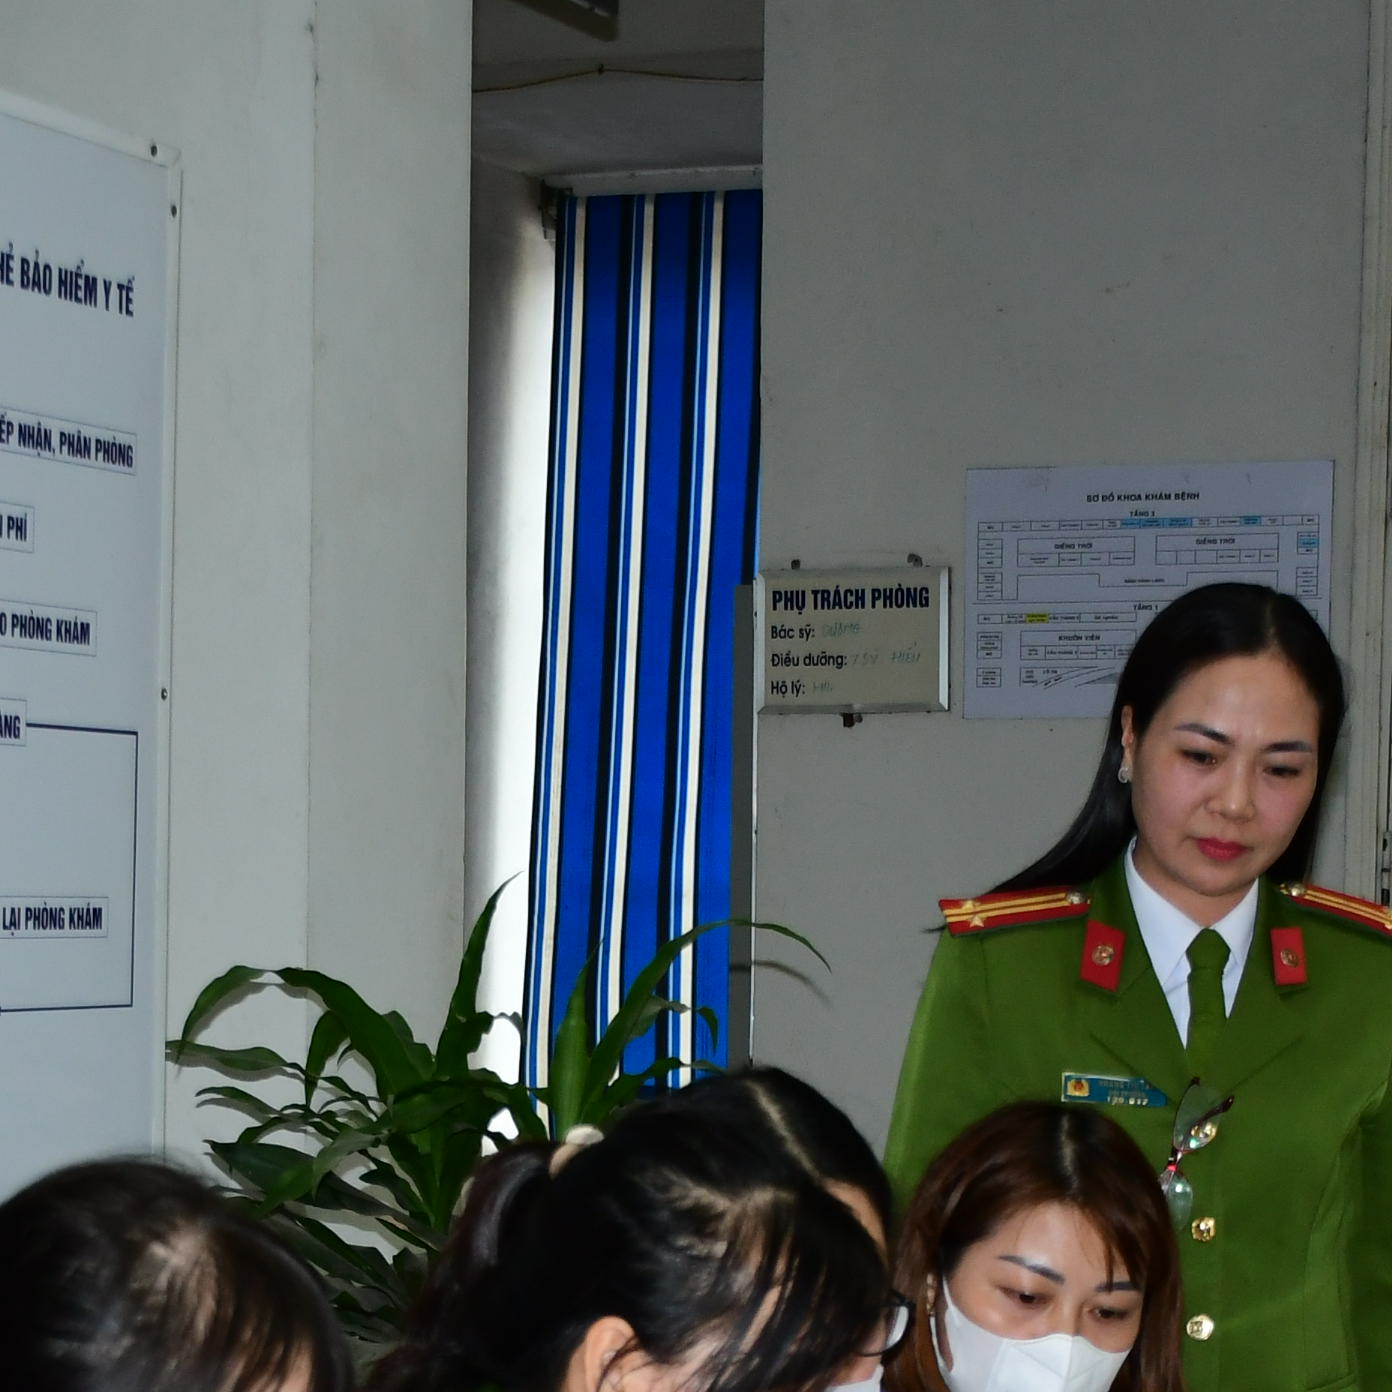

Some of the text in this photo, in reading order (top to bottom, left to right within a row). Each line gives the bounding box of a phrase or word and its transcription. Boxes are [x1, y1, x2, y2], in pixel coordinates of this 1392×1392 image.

[102, 278, 113, 312] Y
[6, 513, 28, 542] PHÍ
[771, 583, 930, 615] PHỤ TRÁCH PHÒNG
[11, 609, 53, 642] PHÒNG
[55, 615, 91, 646] KHÁM
[771, 624, 795, 639] Bác
[799, 624, 815, 641] sỹ:
[771, 650, 799, 667] Điều
[803, 651, 847, 669] dưỡng:
[771, 680, 788, 698] Hộ
[792, 680, 806, 697] lý:
[2, 906, 22, 936] LẠI
[24, 901, 66, 931] PHÒNG
[68, 902, 103, 931] KHÁM
